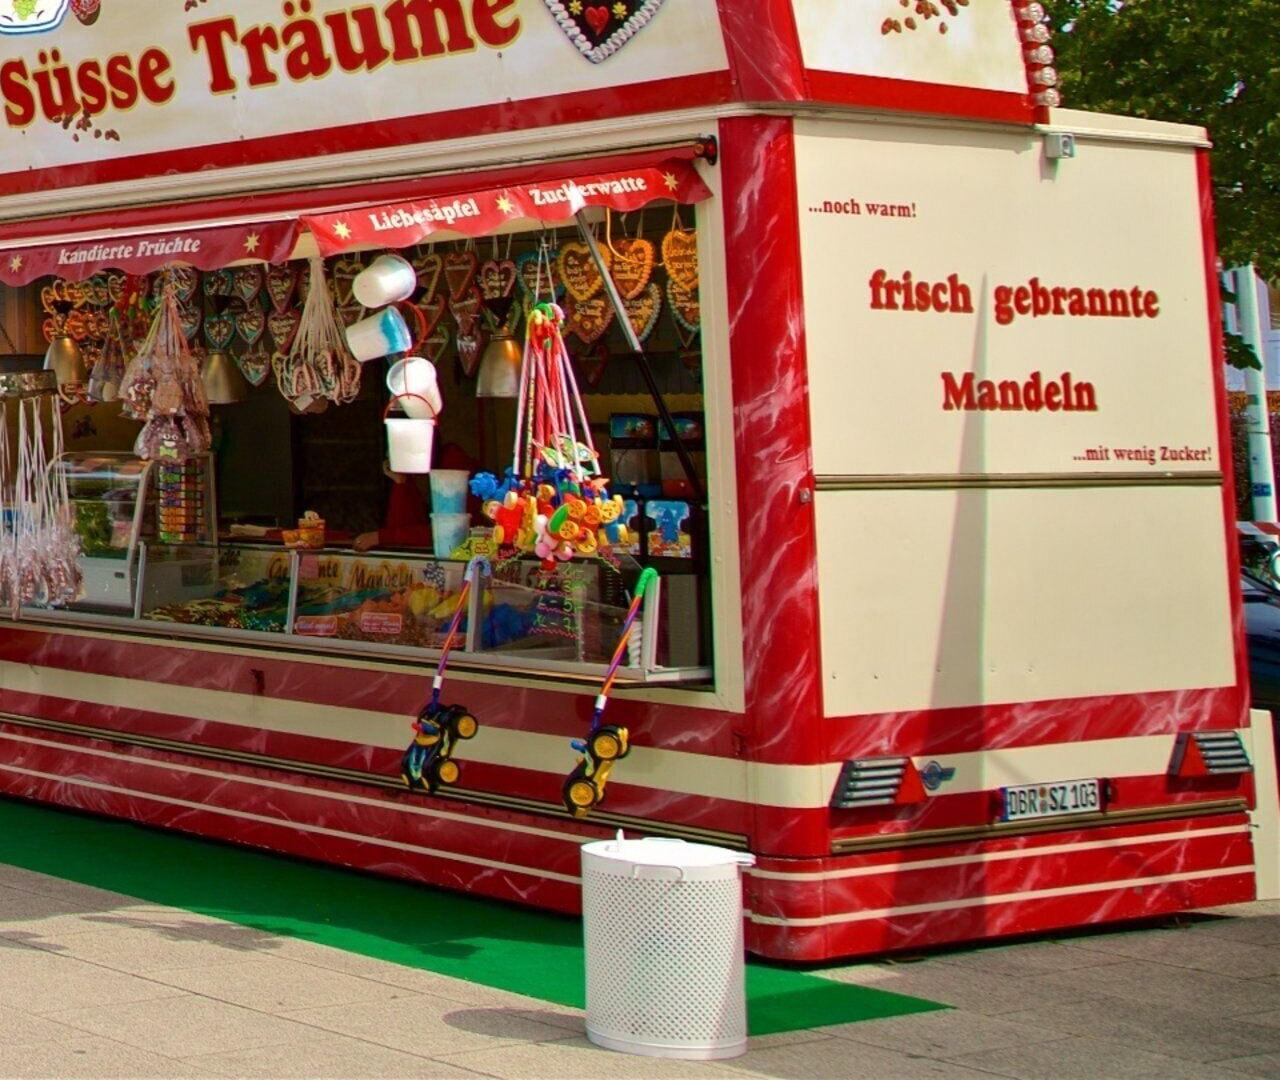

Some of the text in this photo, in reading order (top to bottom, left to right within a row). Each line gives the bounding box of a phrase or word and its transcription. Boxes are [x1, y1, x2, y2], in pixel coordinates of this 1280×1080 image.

[0, 46, 175, 128] Süsse
[369, 197, 480, 231] Liebesäpfel
[866, 202, 917, 217] warm!
[58, 237, 201, 265] kandierte Früchte
[869, 269, 1160, 326] frisch gebrannte
[941, 371, 1098, 412] Mandeln
[1114, 445, 1156, 466] wenig
[1160, 445, 1211, 462] Zucker!
[1010, 782, 1097, 815] DBR SZ 103
